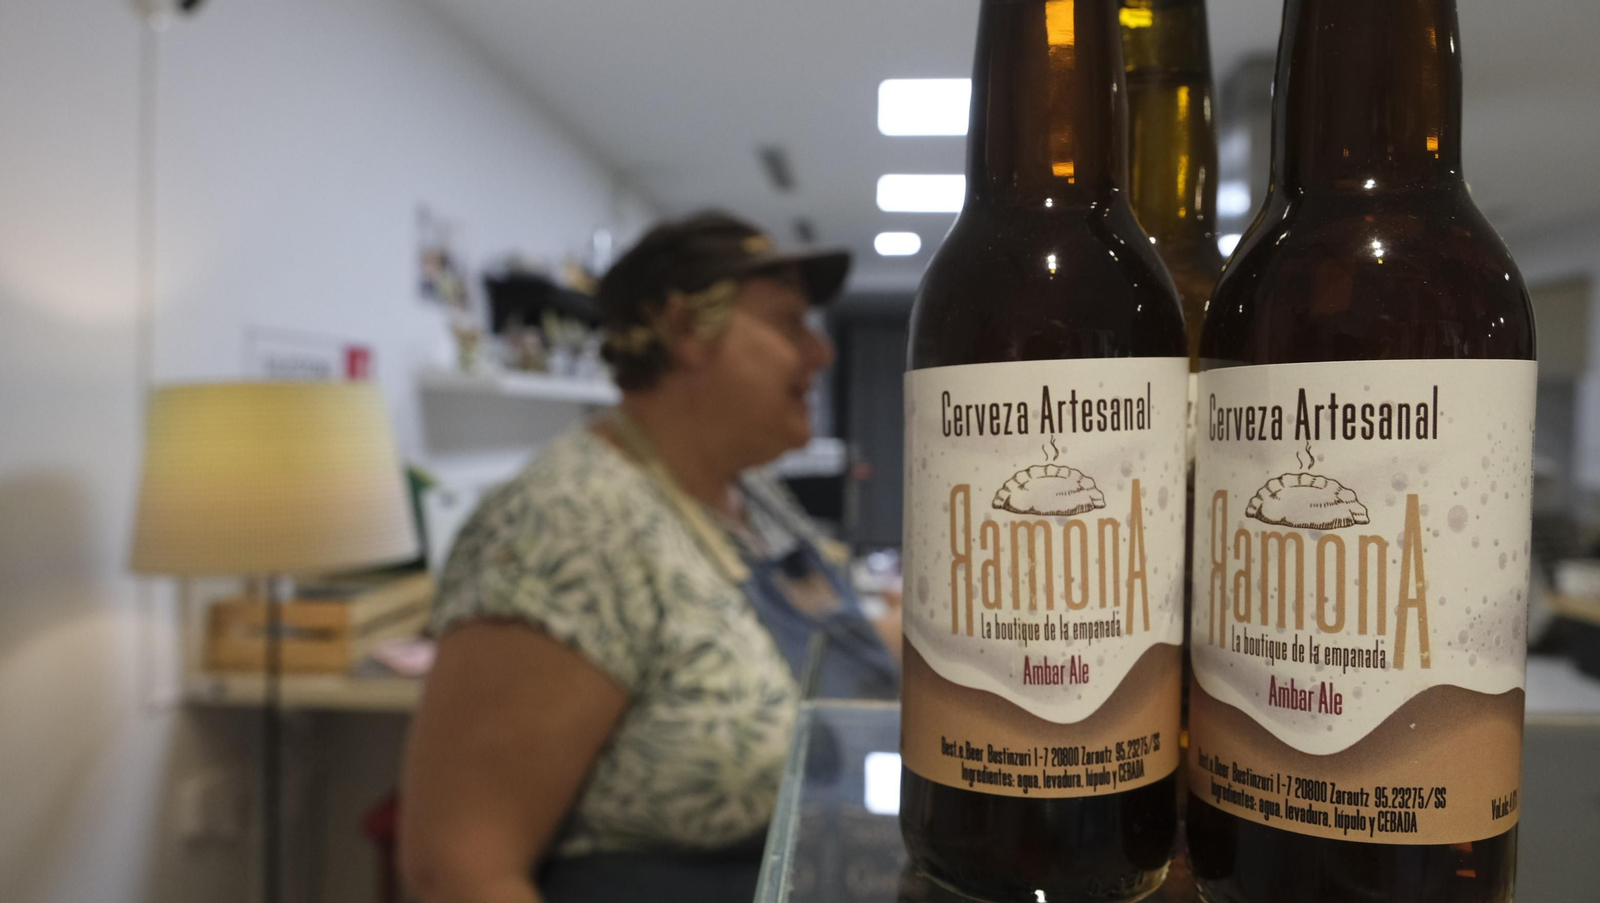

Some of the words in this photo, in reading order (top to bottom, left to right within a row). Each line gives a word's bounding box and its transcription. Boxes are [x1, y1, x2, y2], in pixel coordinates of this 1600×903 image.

[942, 391, 1029, 437] Cerveza
[1040, 382, 1151, 434] Artesanal
[1209, 393, 1283, 441] Cerveza
[1295, 385, 1438, 441] Artesanal
[981, 612, 991, 639] La
[995, 613, 1040, 647] boutique
[1044, 614, 1056, 641] de
[1060, 614, 1069, 641] la
[1073, 611, 1121, 646] empanada
[1232, 625, 1240, 653] La
[1244, 627, 1287, 666] boutique
[1291, 633, 1305, 663] de
[1309, 635, 1320, 665] la
[1324, 639, 1386, 674] empanada
[1023, 655, 1066, 685] Ambar
[1069, 655, 1089, 684] Ale
[1268, 675, 1314, 712] Ambar
[1318, 681, 1343, 716] Ale
[961, 761, 1015, 788] Ingredientes:
[1085, 765, 1110, 792] lúpulo
[1112, 770, 1117, 790] y
[1118, 758, 1144, 783] CEBADA
[987, 744, 1031, 767] Bustinzuri
[1051, 746, 1079, 767] 20800
[1081, 745, 1112, 766] Zarautz
[1211, 775, 1257, 811] Ingredientes:
[1285, 798, 1332, 828] levadura,
[1335, 806, 1366, 836] lúpulo
[1369, 816, 1376, 838] y
[1378, 810, 1418, 833] CEBADA
[1232, 761, 1274, 793] Bustinzuri
[1295, 777, 1327, 803] 20800
[1329, 782, 1370, 808] Zarautz
[1374, 786, 1447, 809] 95.23275/SS
